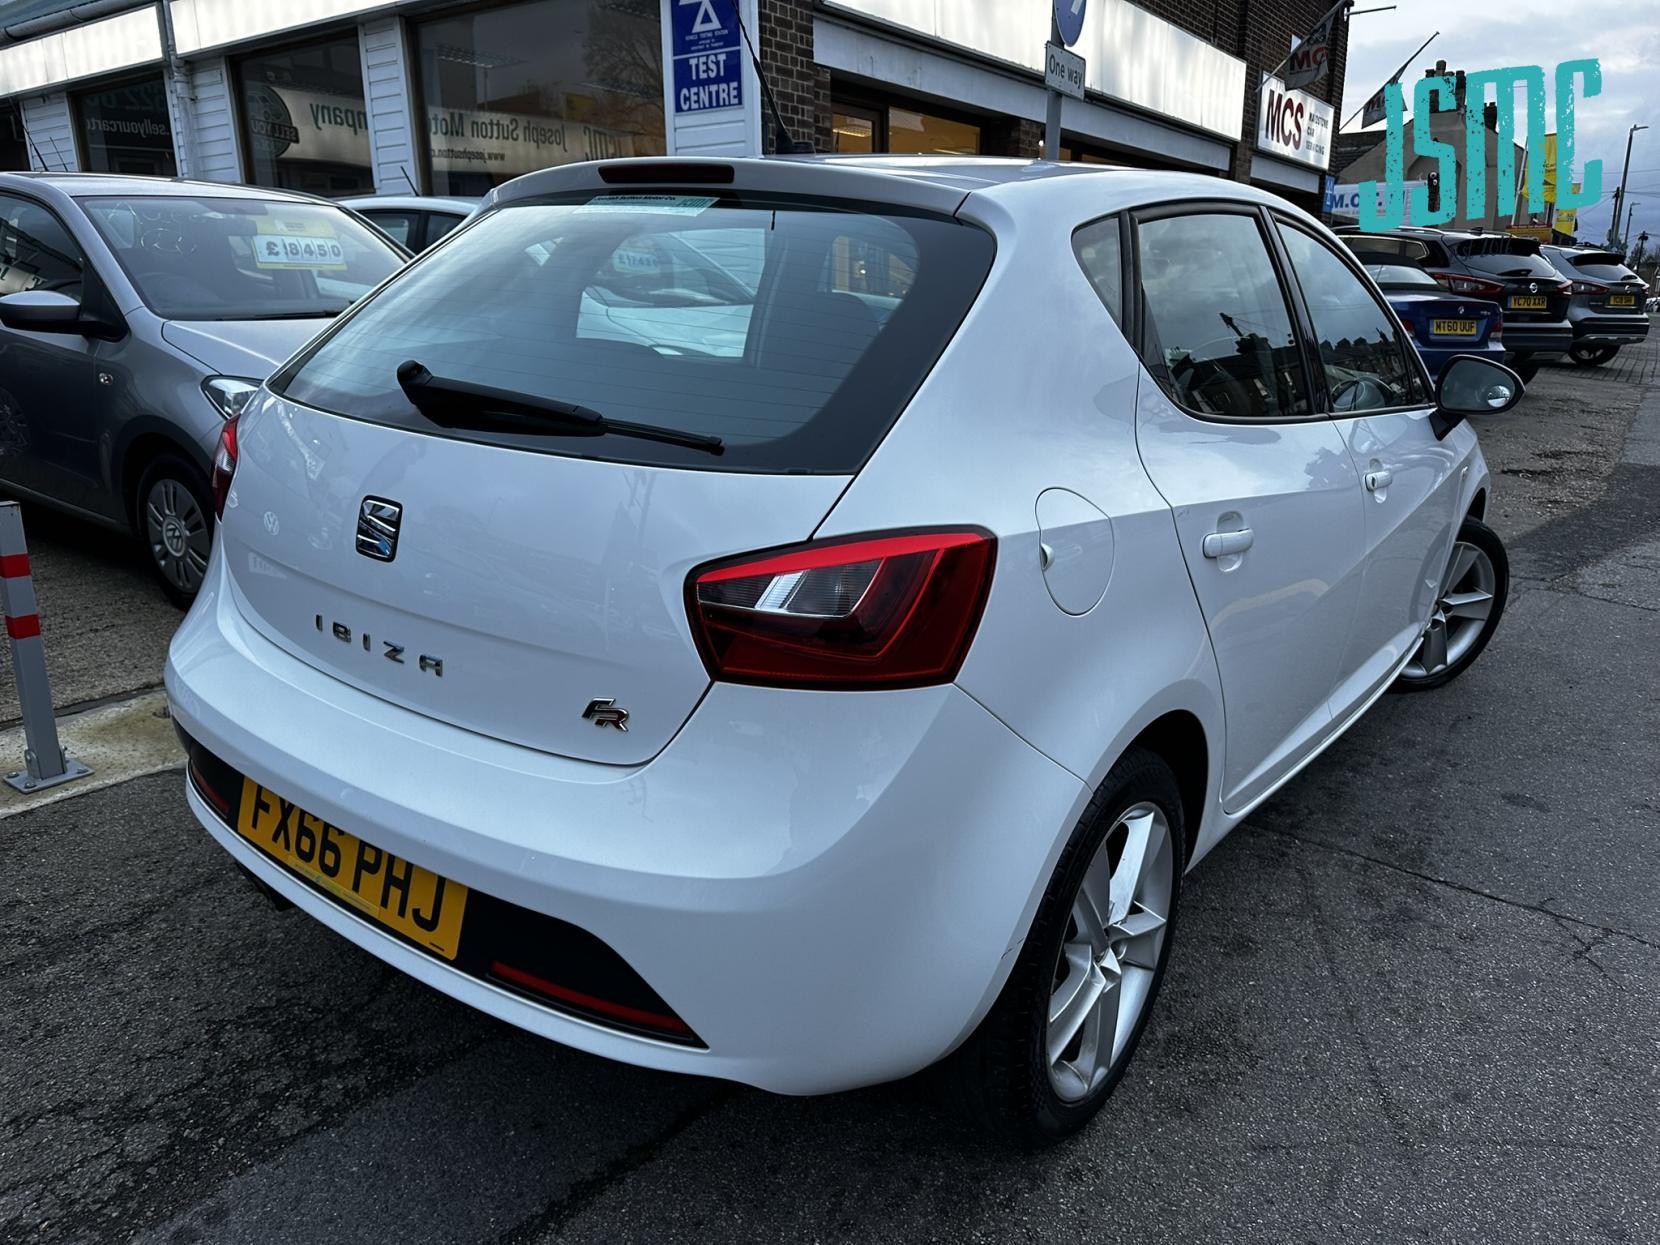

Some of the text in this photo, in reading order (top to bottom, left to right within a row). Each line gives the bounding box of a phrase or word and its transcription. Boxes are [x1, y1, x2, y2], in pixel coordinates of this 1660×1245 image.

[688, 53, 727, 81] TEST
[1049, 54, 1083, 90] One way
[680, 81, 739, 111] CENTRE
[1265, 88, 1304, 150] MCS
[314, 613, 444, 678] IBIZA
[581, 697, 629, 732] FR
[251, 784, 342, 878] FX66
[352, 839, 447, 932] PHJ
